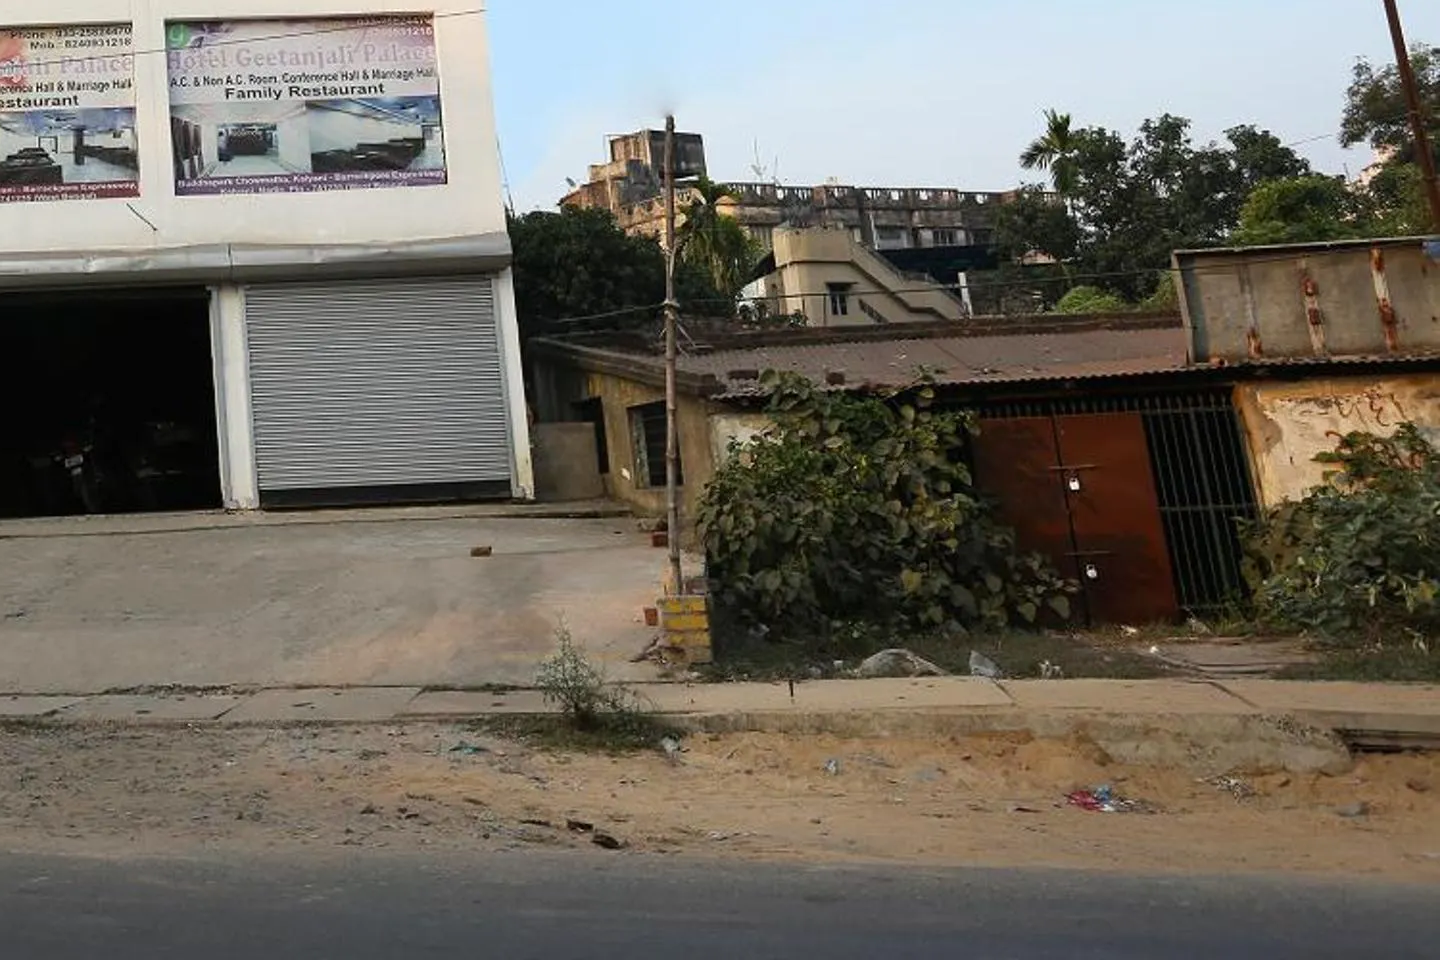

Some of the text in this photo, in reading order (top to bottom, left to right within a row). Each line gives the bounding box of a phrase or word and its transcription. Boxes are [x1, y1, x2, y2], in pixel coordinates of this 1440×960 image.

[168, 43, 435, 71] Hotel Geetanjali Palace
[36, 82, 54, 93] Hall
[57, 81, 64, 92] &
[67, 80, 109, 93] Marriage
[112, 78, 132, 89] Hall
[194, 77, 201, 87] &
[203, 75, 224, 86] Non
[282, 71, 338, 83] Conference
[341, 70, 360, 81] Hall
[362, 69, 369, 79] &
[372, 68, 414, 82] Marriage
[225, 83, 385, 100] Family Restaurant
